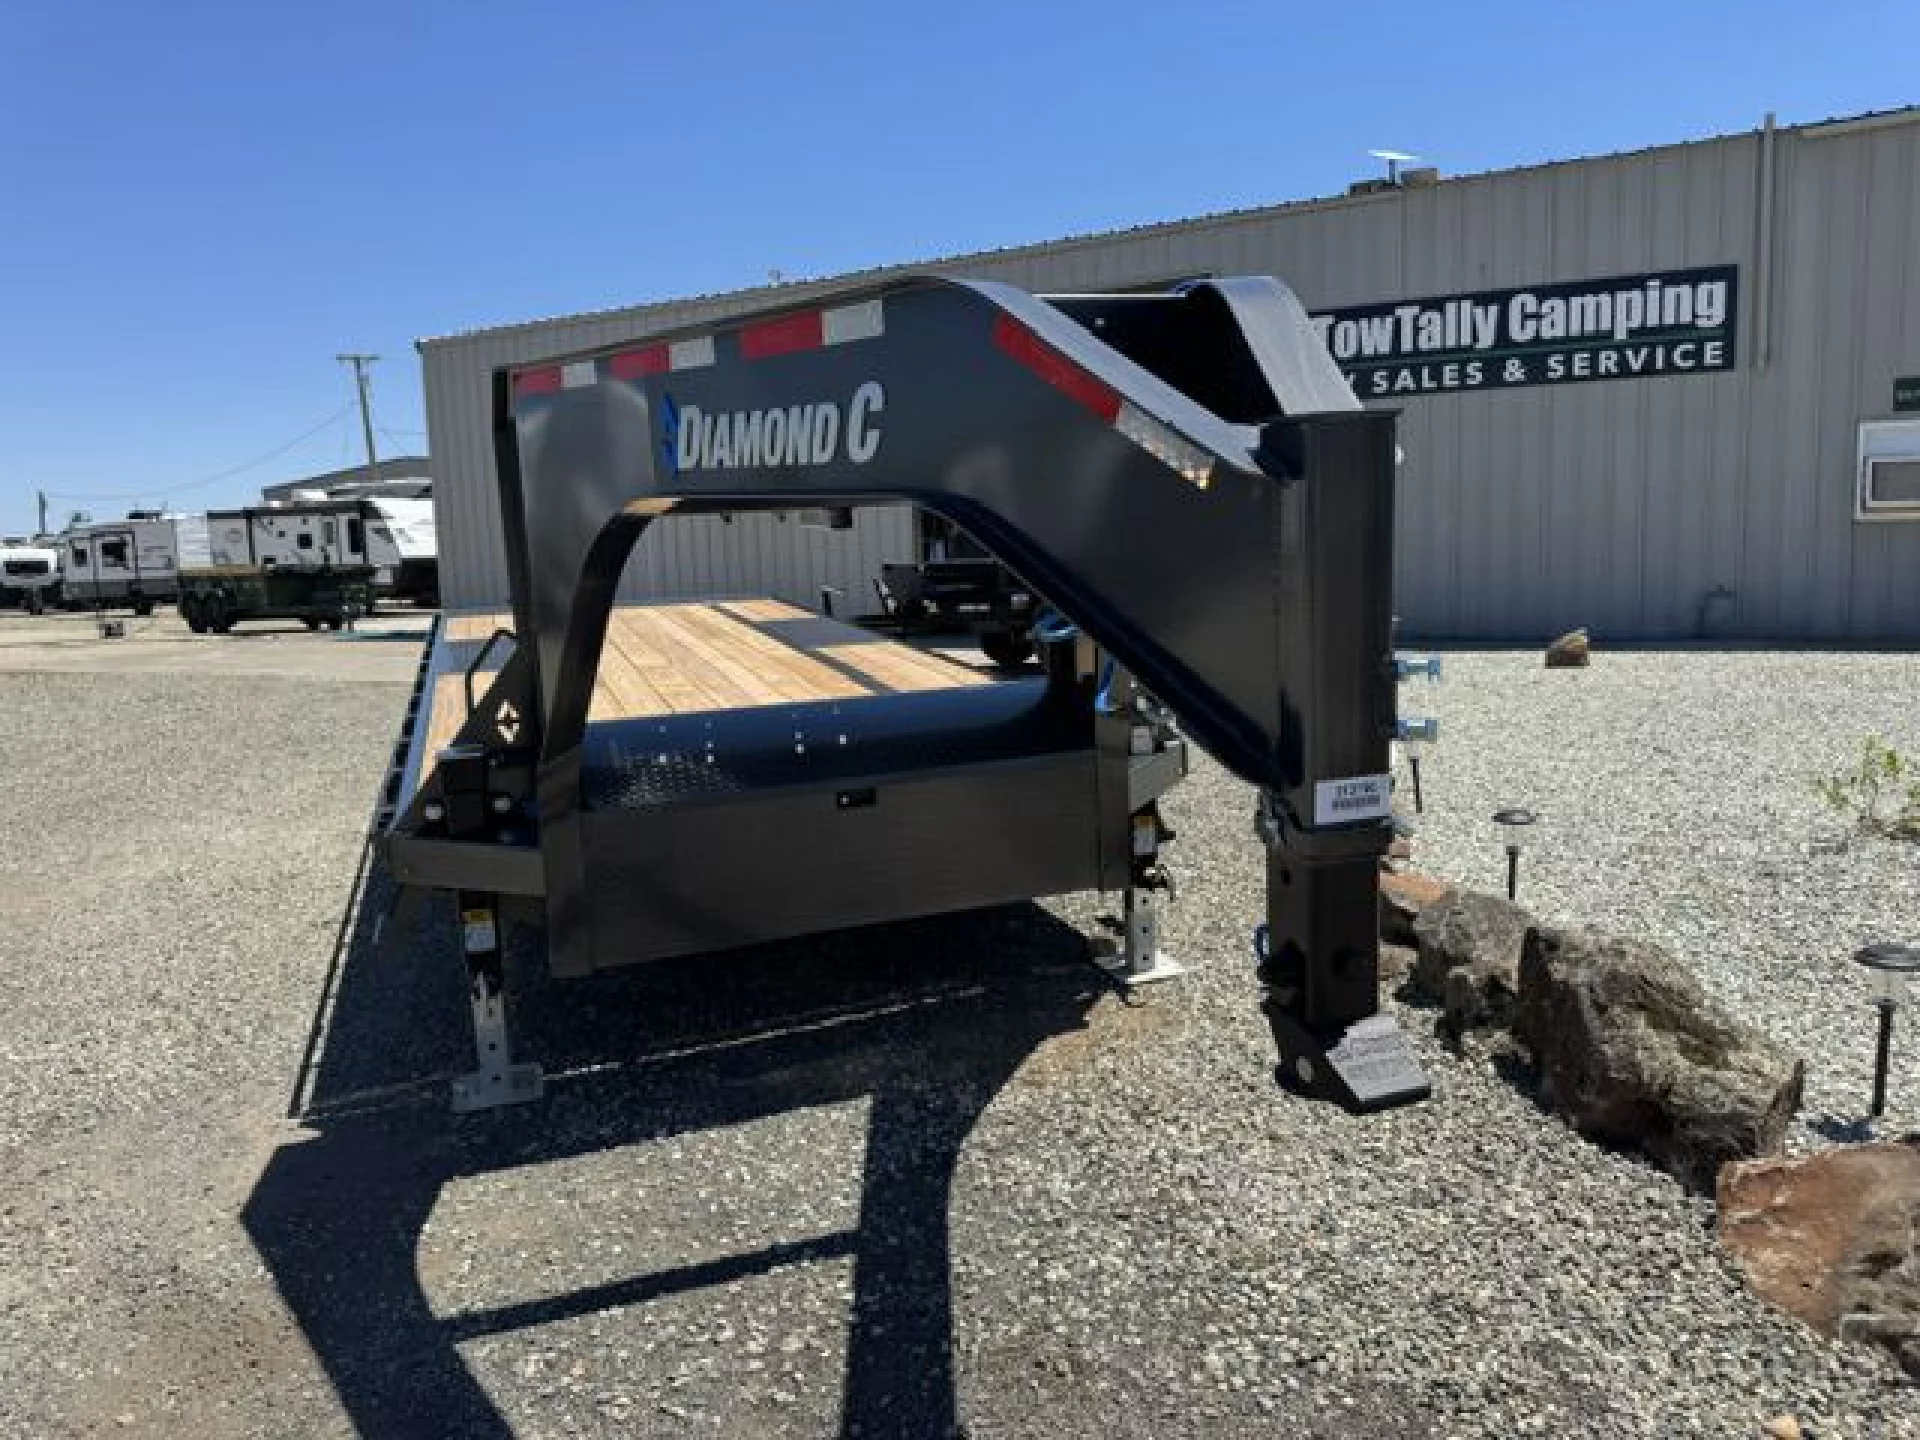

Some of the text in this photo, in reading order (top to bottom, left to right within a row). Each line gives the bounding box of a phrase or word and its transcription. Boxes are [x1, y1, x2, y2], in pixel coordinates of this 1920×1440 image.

[1508, 279, 1727, 342] Camping
[1371, 358, 1484, 394] SALES
[1502, 357, 1527, 382] &
[1547, 341, 1725, 379] SERVICE
[677, 380, 884, 469] DIAMOND C
